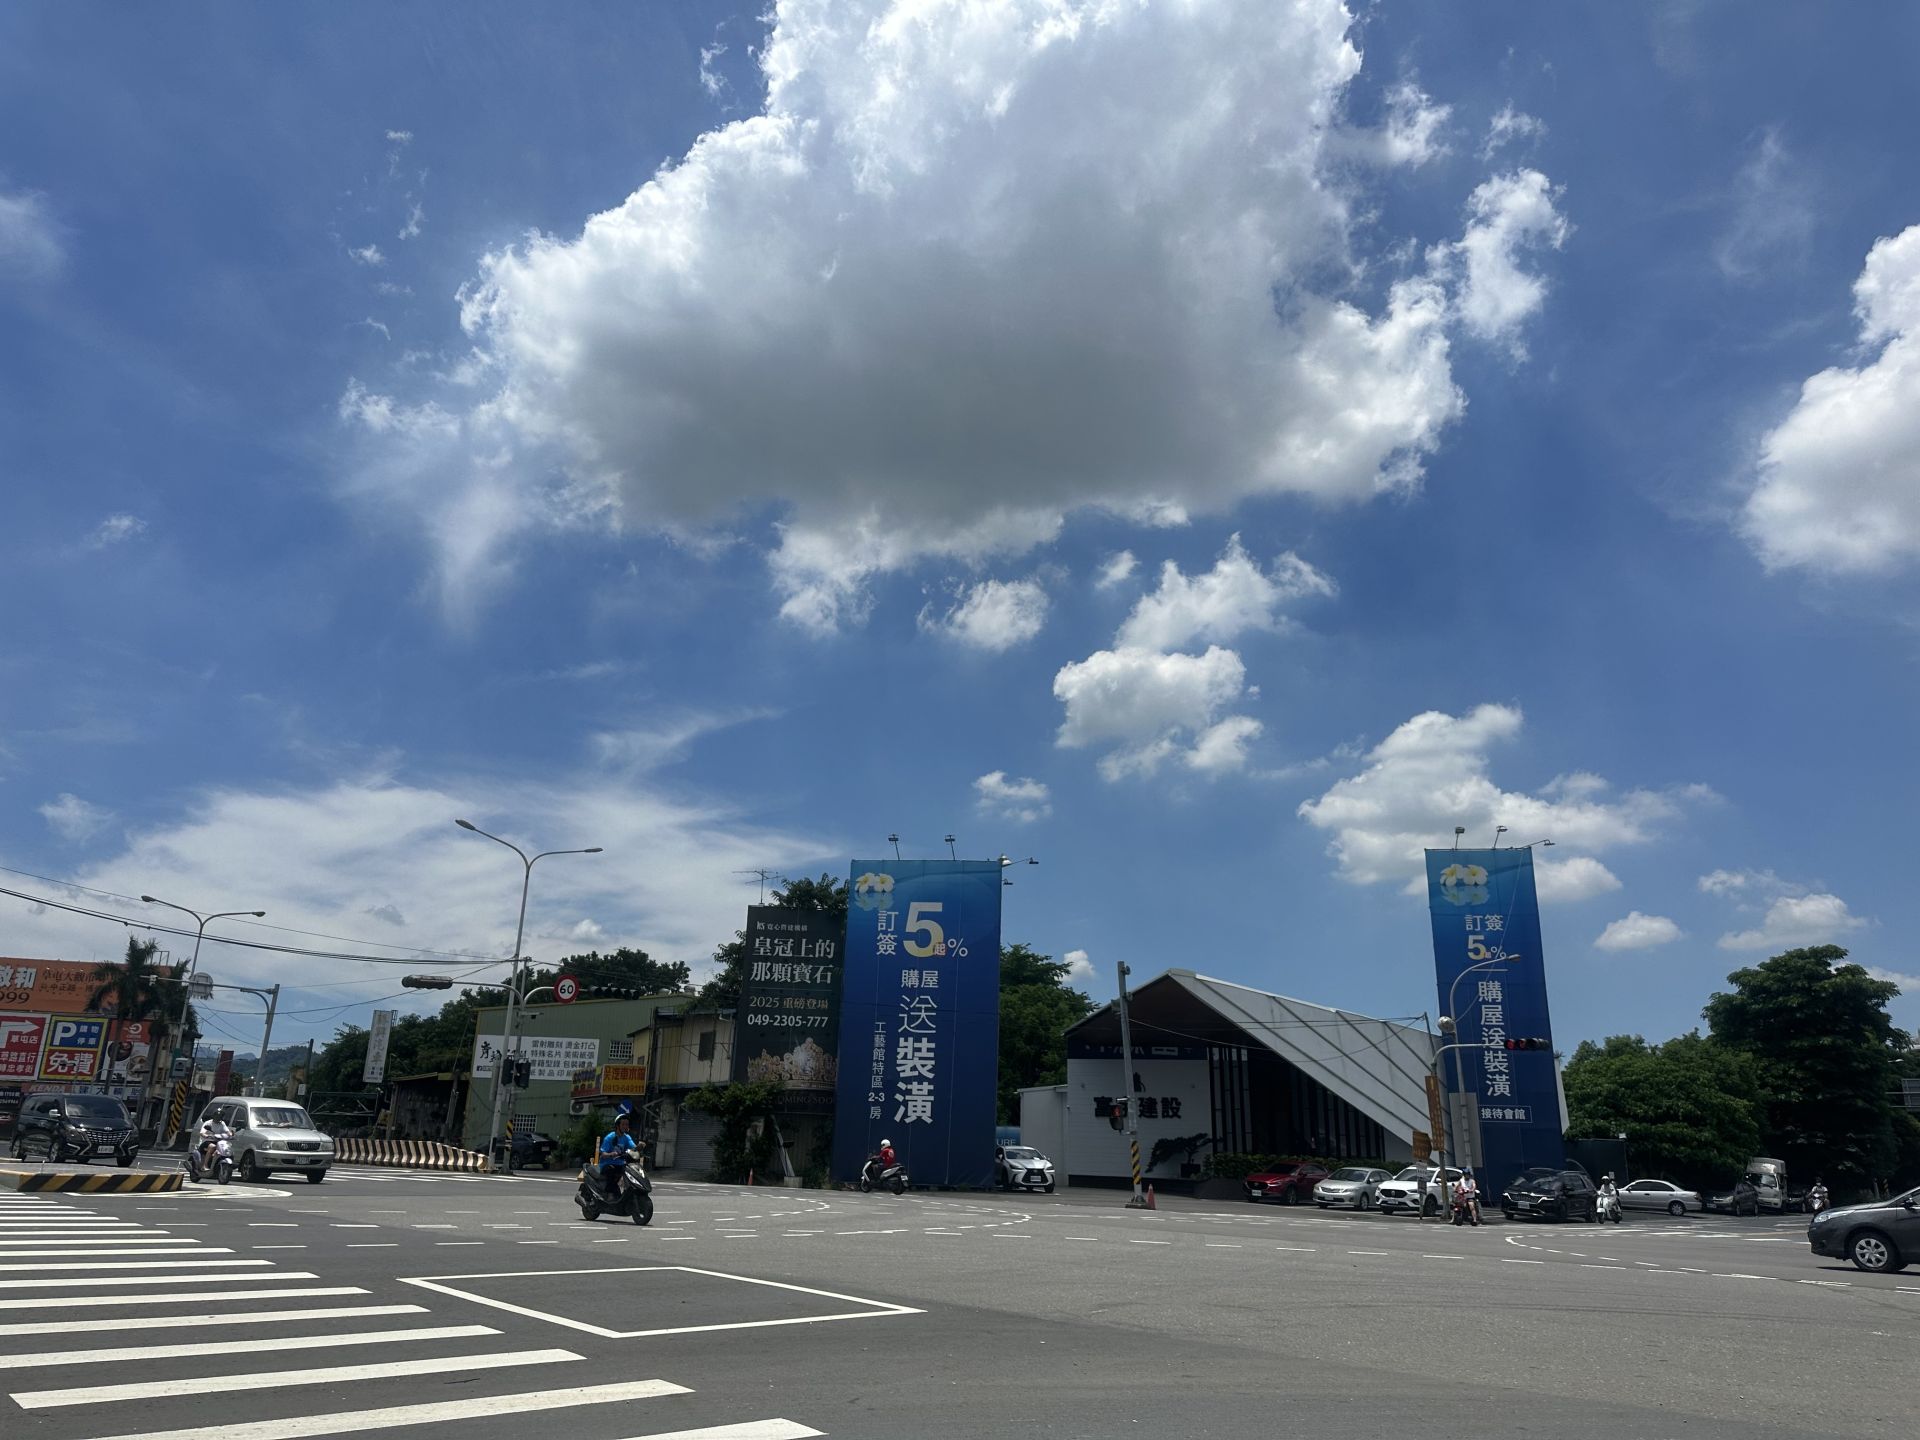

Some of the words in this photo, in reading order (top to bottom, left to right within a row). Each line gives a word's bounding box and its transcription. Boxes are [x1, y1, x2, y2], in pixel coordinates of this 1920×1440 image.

[1465, 914, 1504, 931] 訂簽
[876, 911, 899, 955] 訂簽
[752, 937, 835, 958] 皇冠上的
[750, 962, 834, 984] 那顆寶石
[901, 969, 939, 988] 購屋
[560, 985, 574, 994] 60
[750, 996, 780, 1008] 2025
[747, 1014, 829, 1027] 049-2305-777
[53, 1021, 77, 1046] P
[1478, 981, 1512, 1096] 購屋送裝潢
[46, 1052, 93, 1075] 免費
[1481, 1108, 1526, 1120] 接待會館
